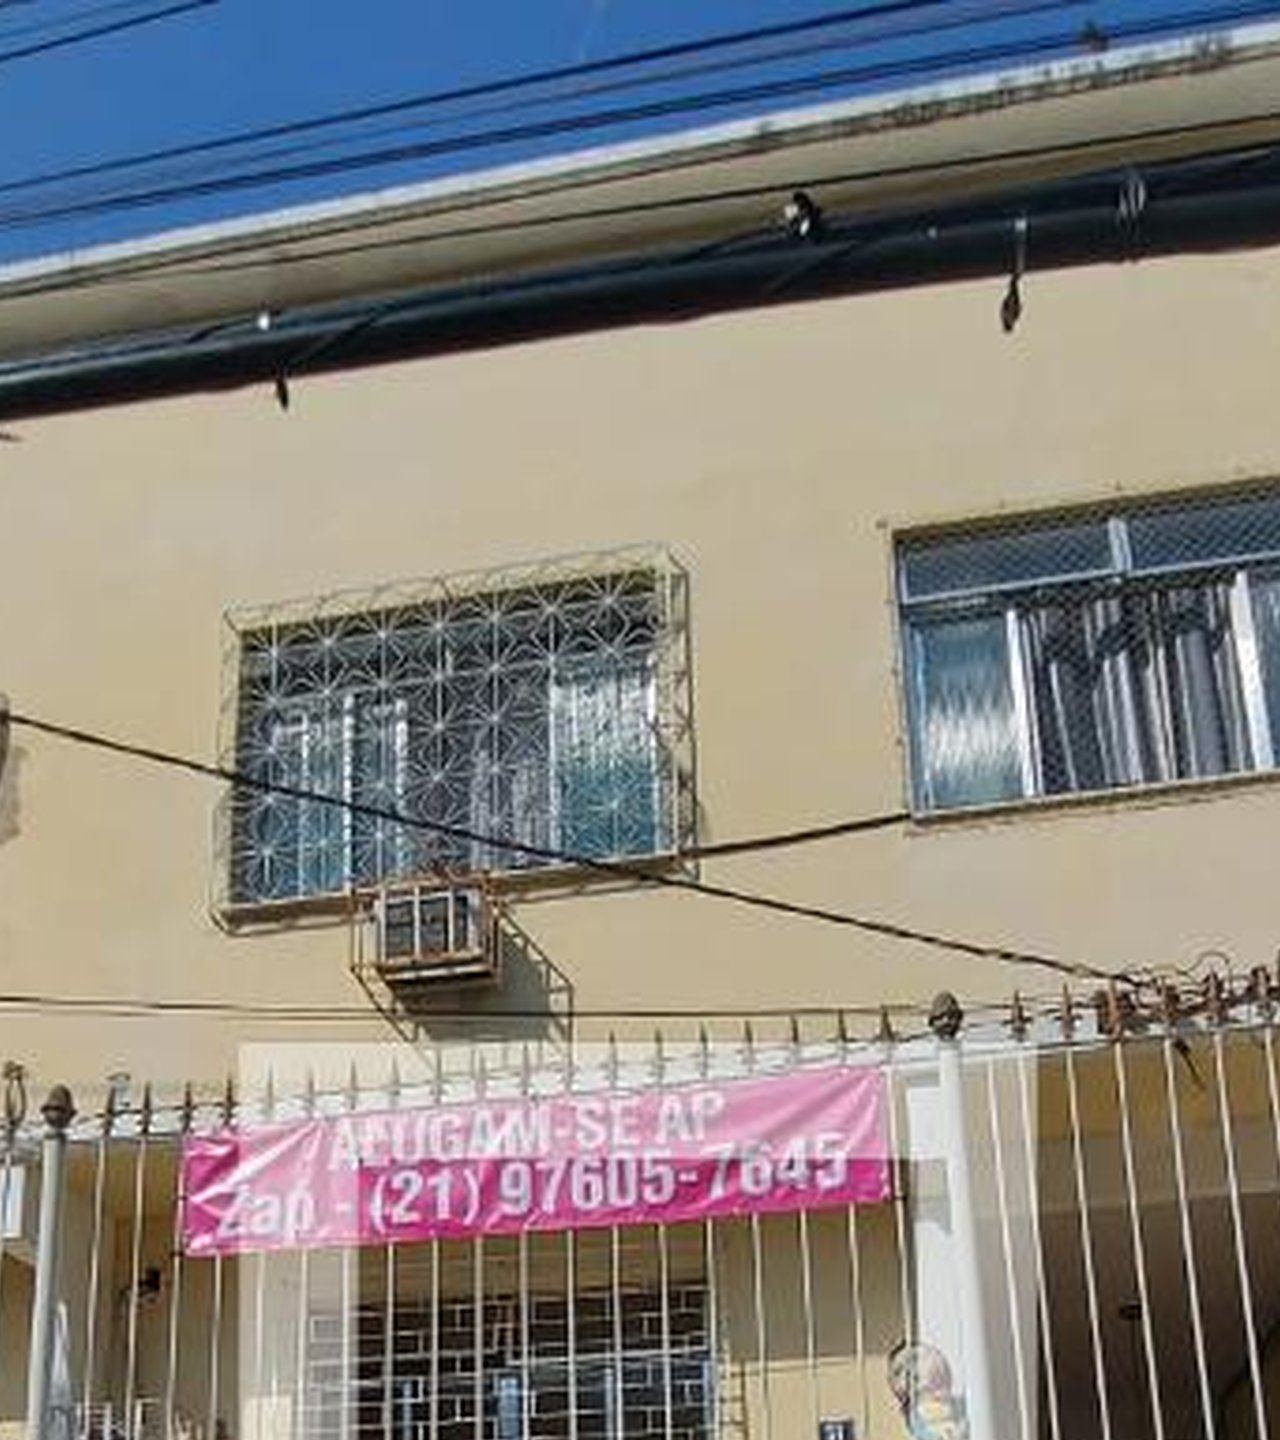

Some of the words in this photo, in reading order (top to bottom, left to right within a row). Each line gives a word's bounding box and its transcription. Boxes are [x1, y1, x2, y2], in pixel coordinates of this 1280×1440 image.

[656, 1091, 724, 1143] AP
[371, 1167, 480, 1236] (21)
[499, 1131, 848, 1216] 97605-7645
